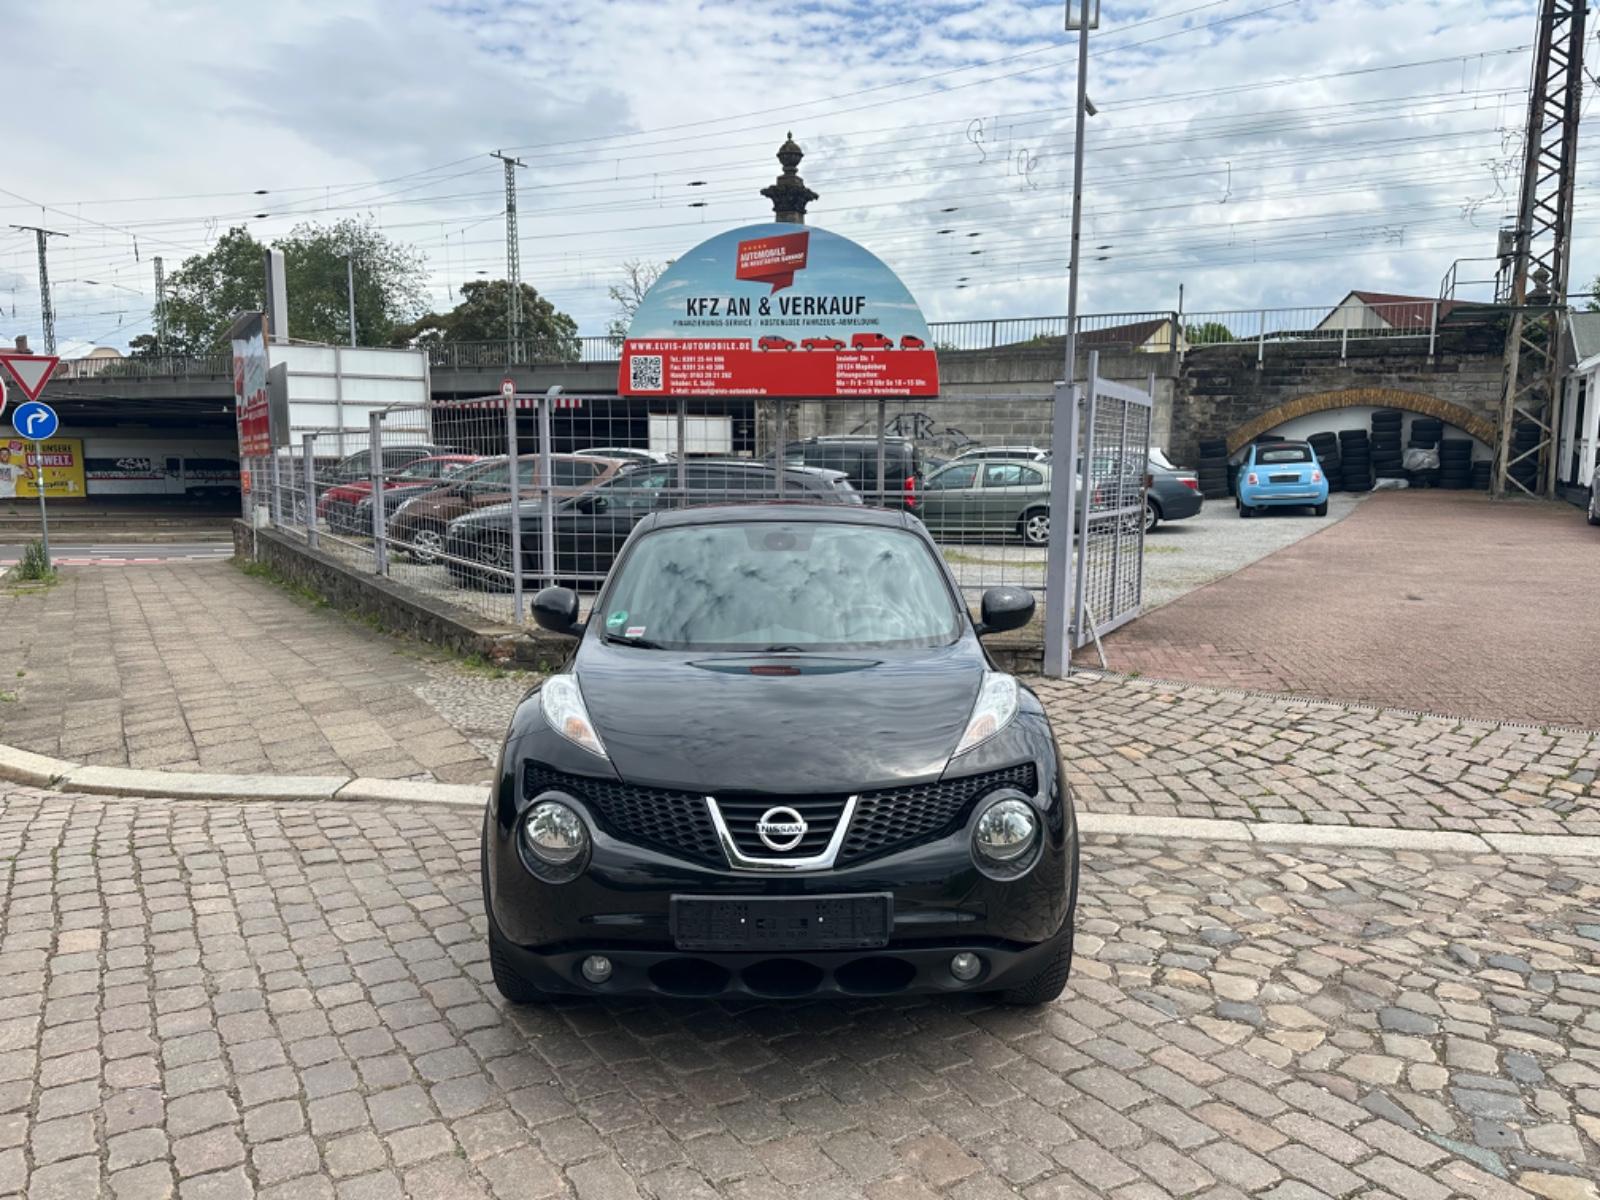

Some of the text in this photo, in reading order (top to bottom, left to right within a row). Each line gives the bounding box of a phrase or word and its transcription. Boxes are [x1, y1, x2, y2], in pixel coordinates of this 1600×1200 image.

[740, 247, 786, 261] AUTOMOBILE
[686, 296, 866, 317] KFZ AN & VERKAUF
[760, 318, 800, 326] KOSTENLOSE
[630, 342, 750, 350] WWW.ELVIS-AUTOMOBILE.DE
[855, 363, 886, 371] Magdeburg
[761, 825, 802, 833] NISSAN
